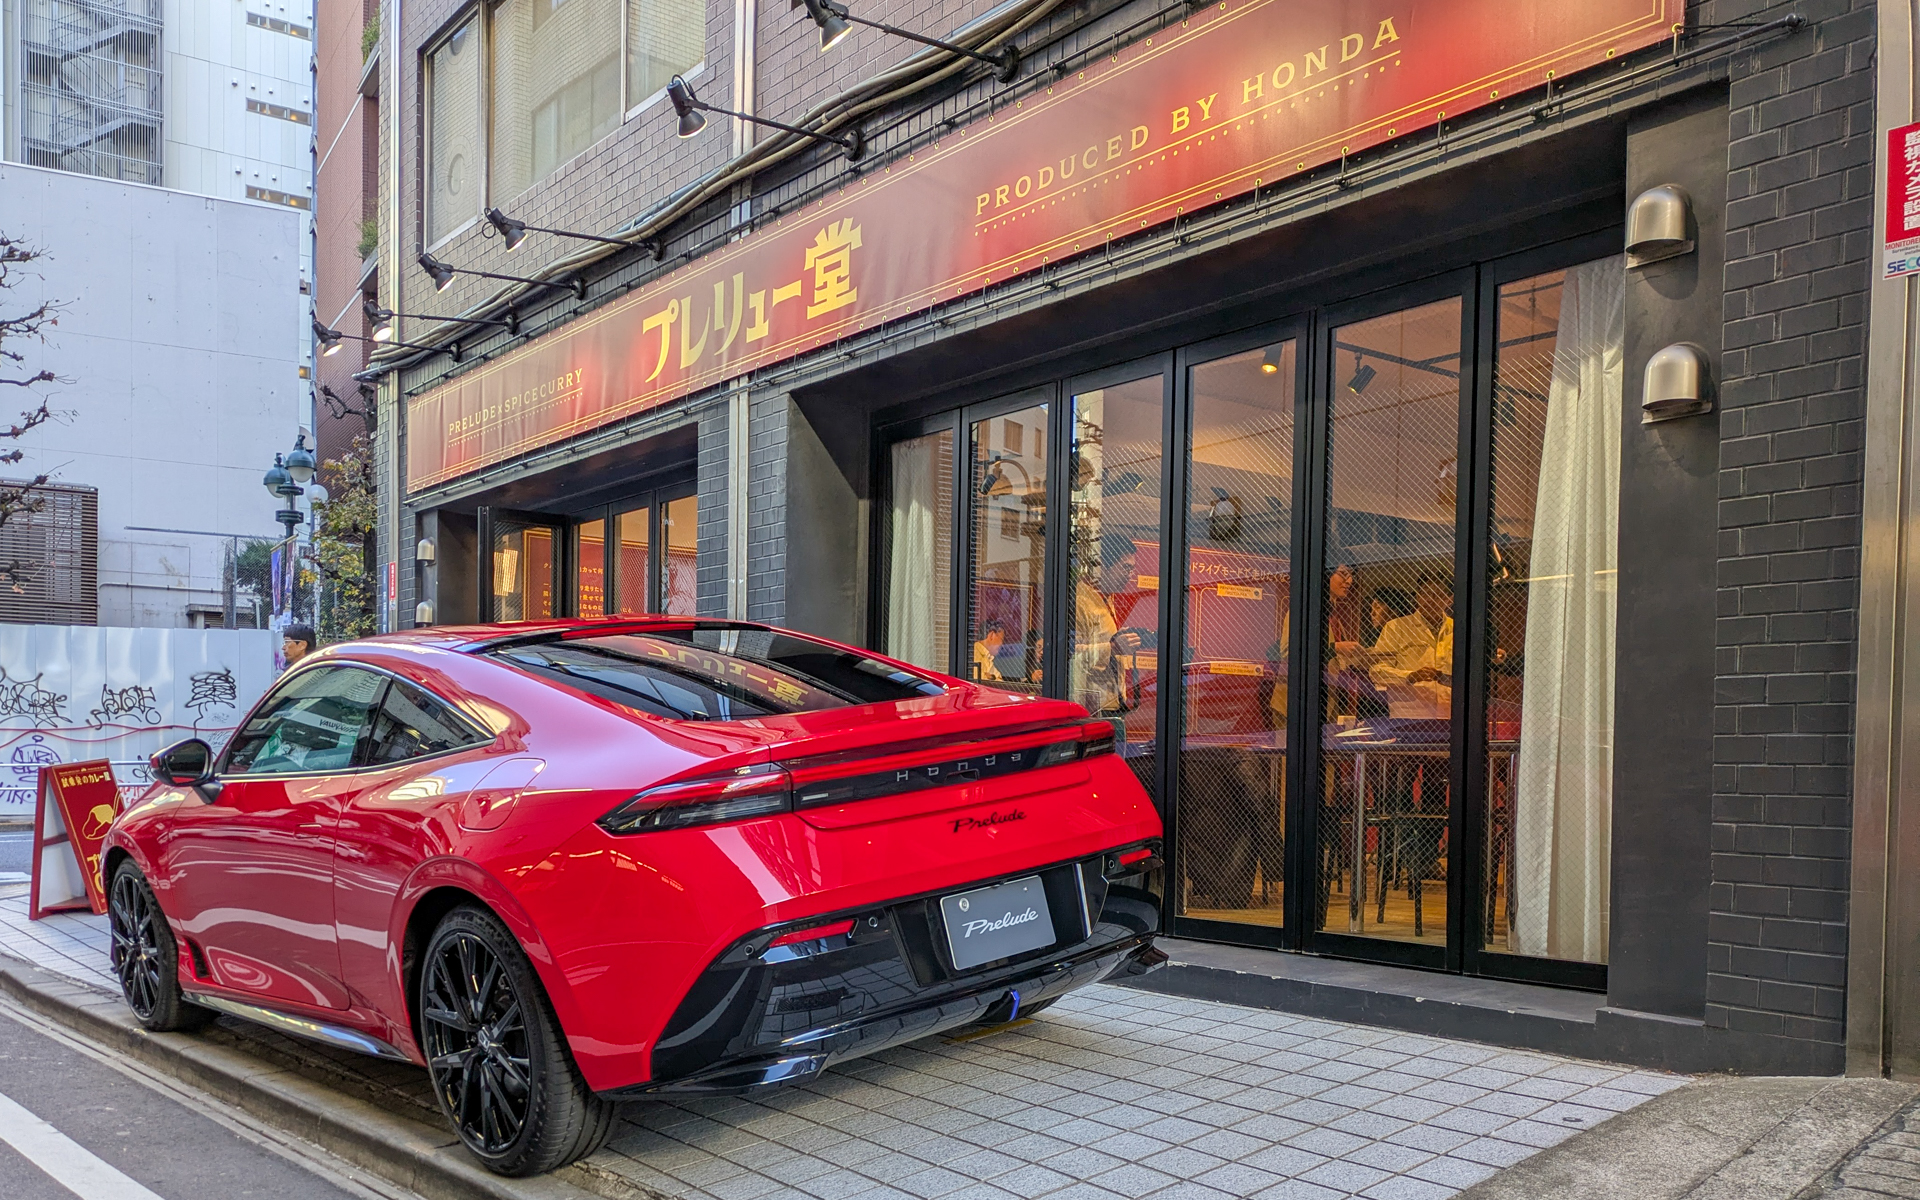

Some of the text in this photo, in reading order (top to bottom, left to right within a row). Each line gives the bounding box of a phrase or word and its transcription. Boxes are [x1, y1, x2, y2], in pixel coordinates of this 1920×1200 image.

[975, 16, 1400, 216] PRODUCED BY HONDA
[643, 217, 863, 383] プレリュー堂
[949, 809, 1027, 833] Prelude
[962, 907, 1039, 938] Prelude
